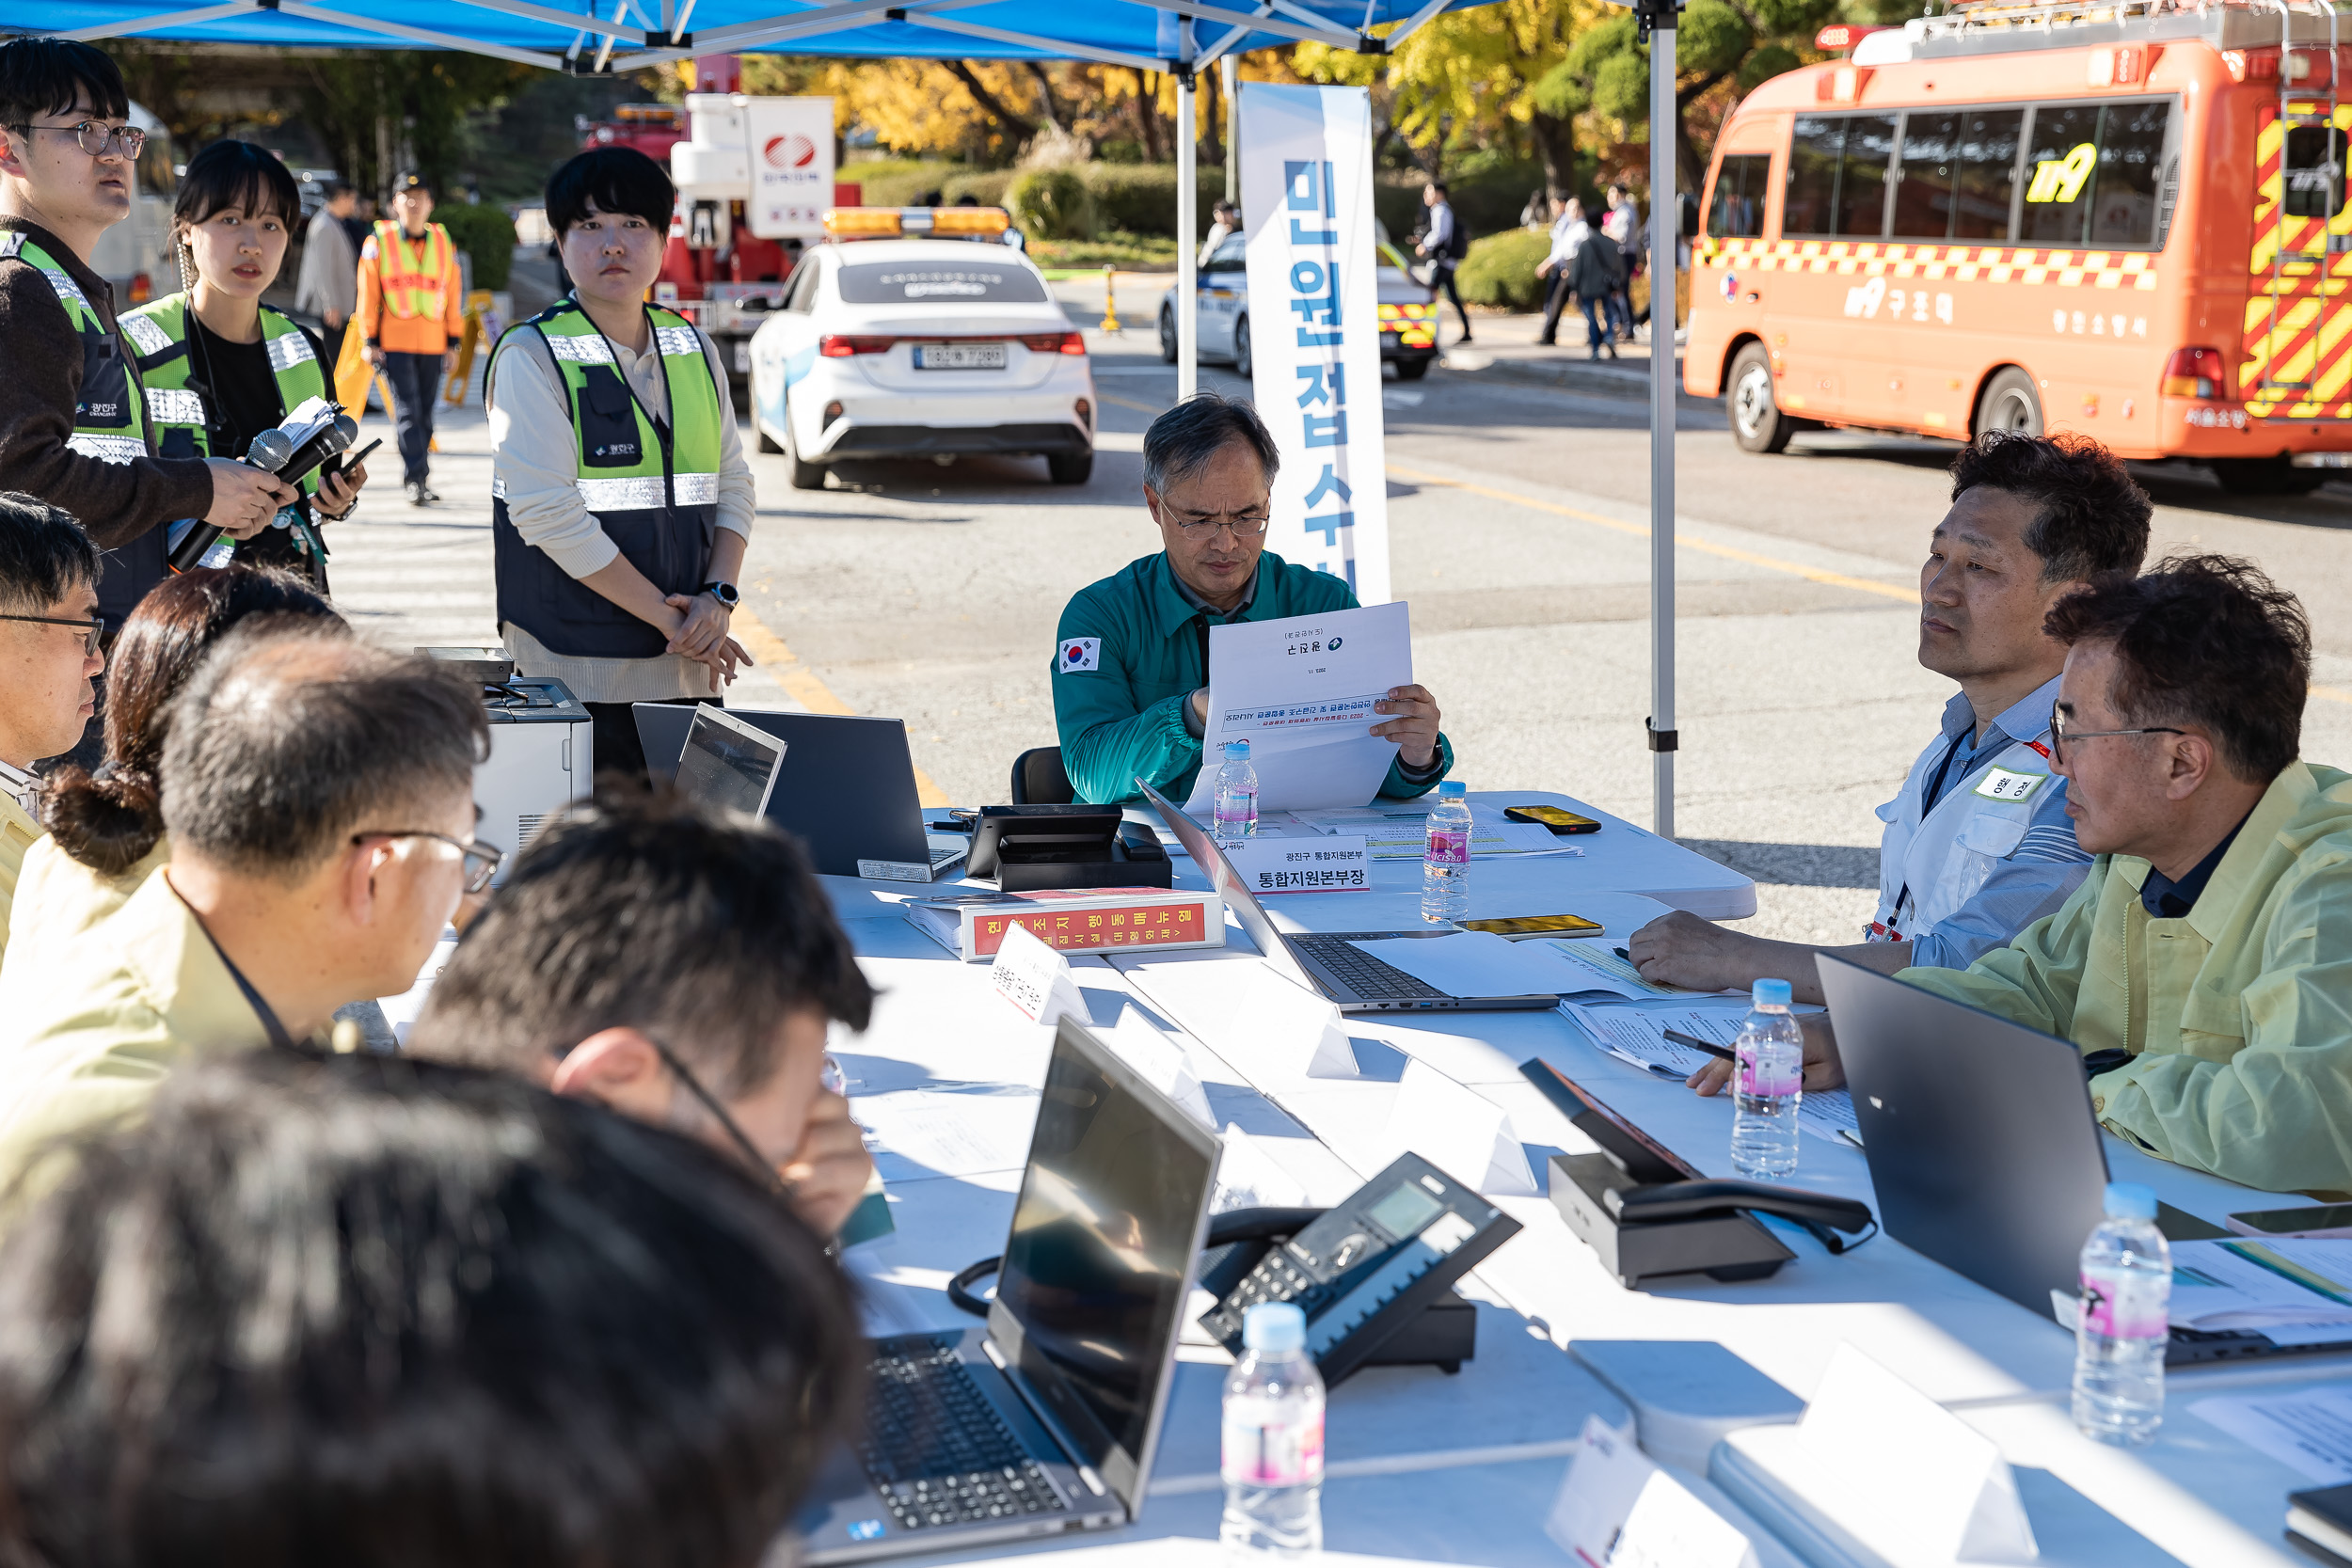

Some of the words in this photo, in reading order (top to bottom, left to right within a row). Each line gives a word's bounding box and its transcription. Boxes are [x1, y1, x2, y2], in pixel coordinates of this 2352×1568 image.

[2026, 142, 2097, 203] 119
[91, 403, 118, 413] 광진구
[1287, 641, 1321, 656] 광진구
[1225, 712, 1254, 721] 시나리오
[1285, 851, 1311, 862] 광진구
[1314, 850, 1363, 861] 통합지원본부
[1258, 869, 1364, 888] 통합지원본부장
[1088, 910, 1192, 929] 행동매뉴얼
